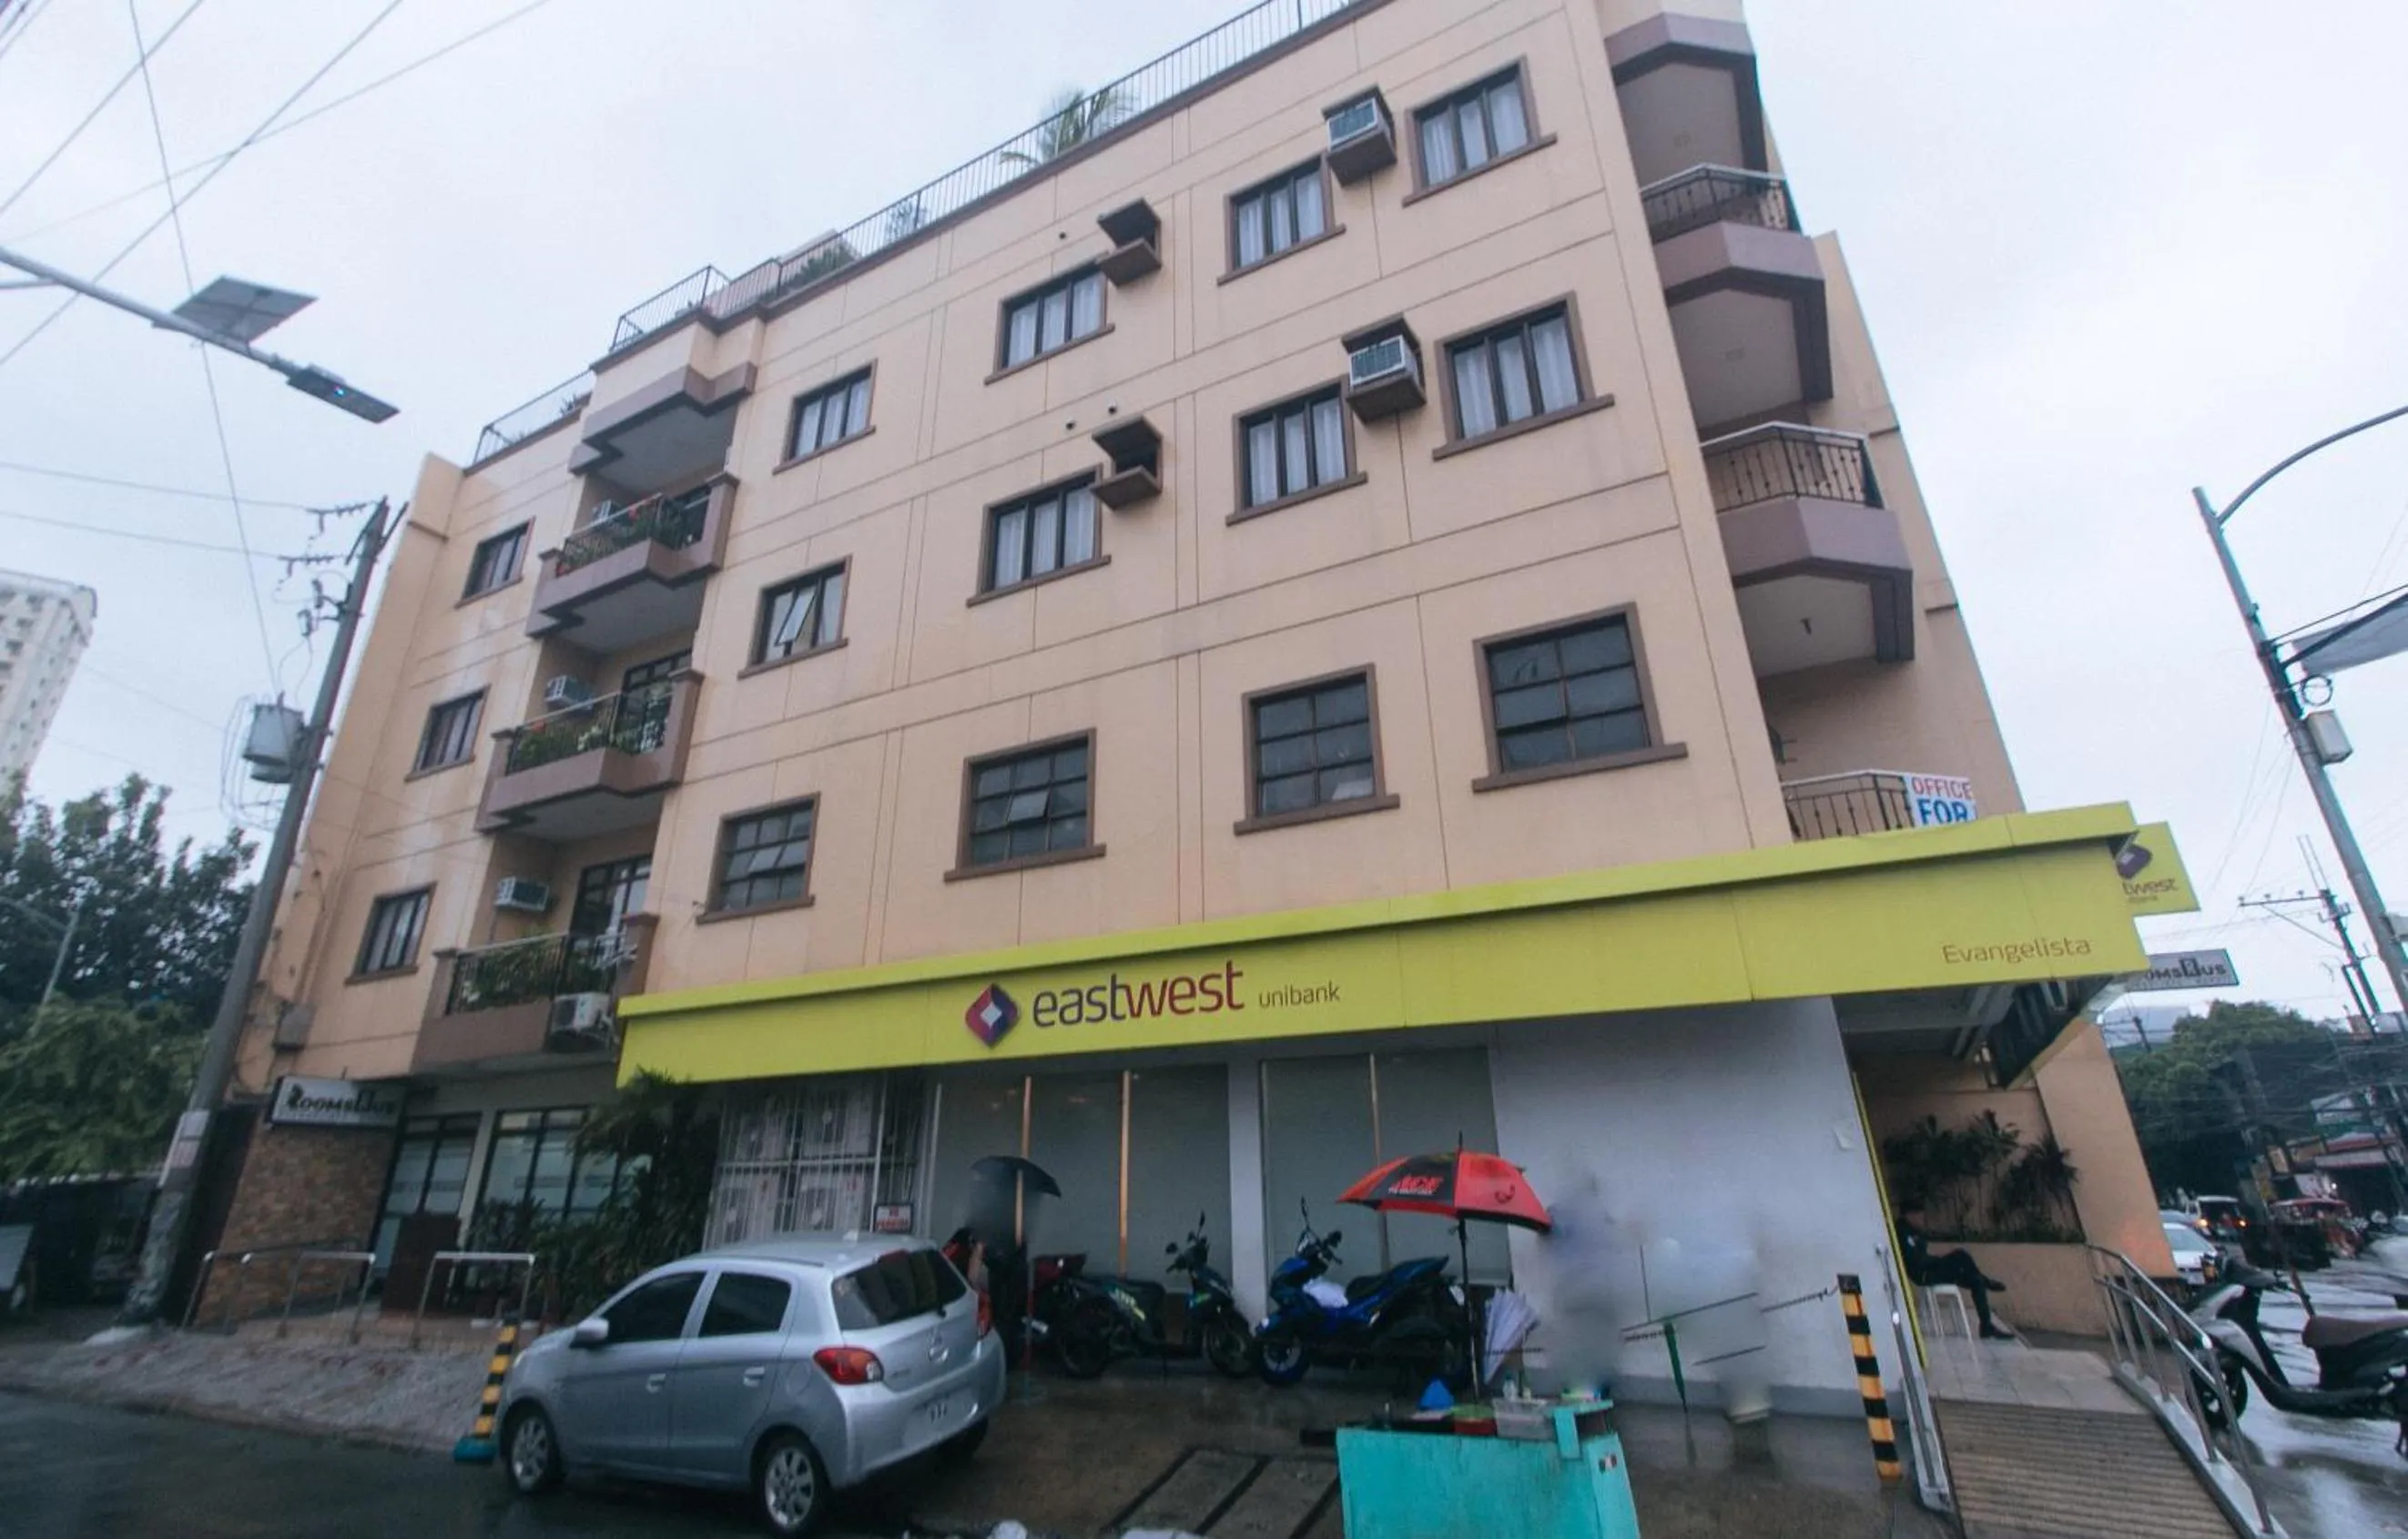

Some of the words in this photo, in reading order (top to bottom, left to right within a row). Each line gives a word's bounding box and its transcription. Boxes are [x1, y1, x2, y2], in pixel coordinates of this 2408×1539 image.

[1911, 775, 1973, 801] OFFICE
[1915, 797, 1969, 825] FOR
[2121, 876, 2179, 896] twest
[1941, 936, 2092, 965] Evangelista
[1032, 958, 1245, 1028] eastwest
[1257, 979, 1341, 1009] unibank
